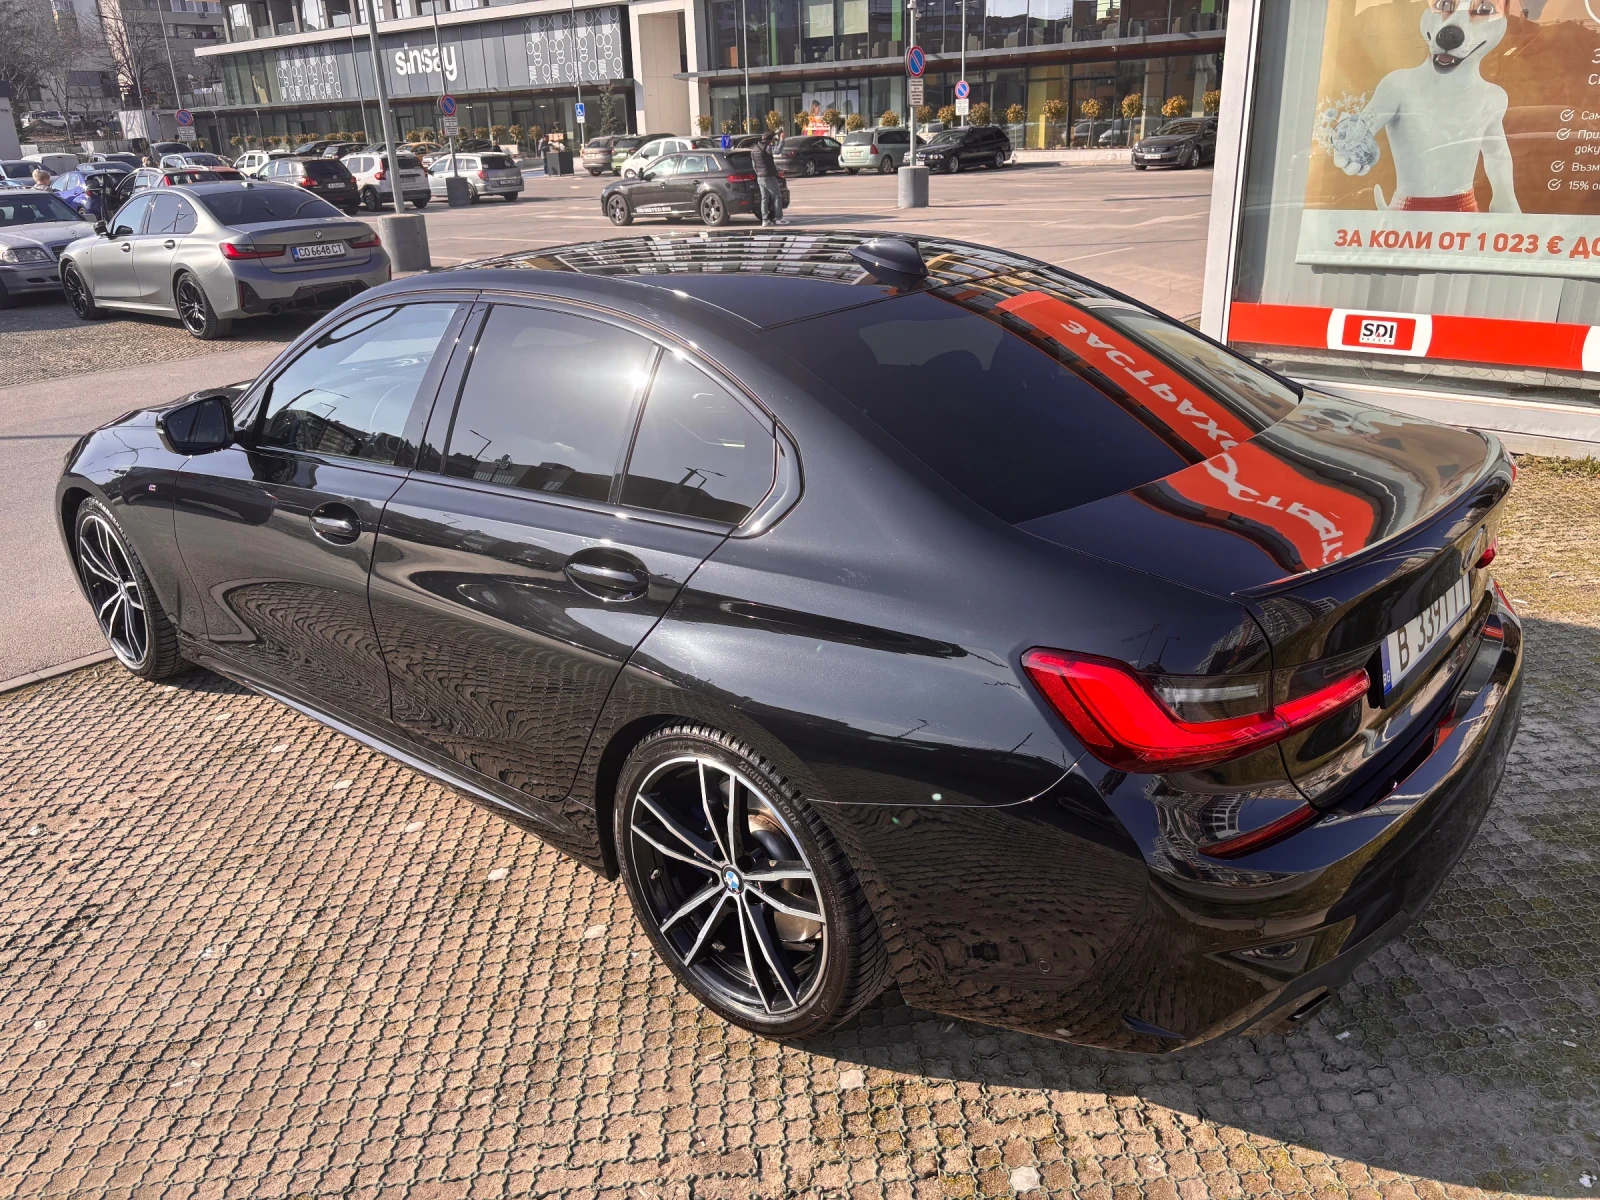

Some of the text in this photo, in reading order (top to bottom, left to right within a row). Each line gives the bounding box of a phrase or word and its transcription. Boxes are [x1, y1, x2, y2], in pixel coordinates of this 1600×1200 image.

[395, 42, 458, 81] sinsay
[1568, 180, 1590, 190] 15%
[1334, 229, 1362, 248] ЗА
[1368, 230, 1433, 249] КОЛИ
[1438, 231, 1472, 251] ОТ
[1546, 235, 1565, 255] €
[1362, 322, 1394, 339] SDI
[737, 760, 802, 828] BRIDGESTONE
